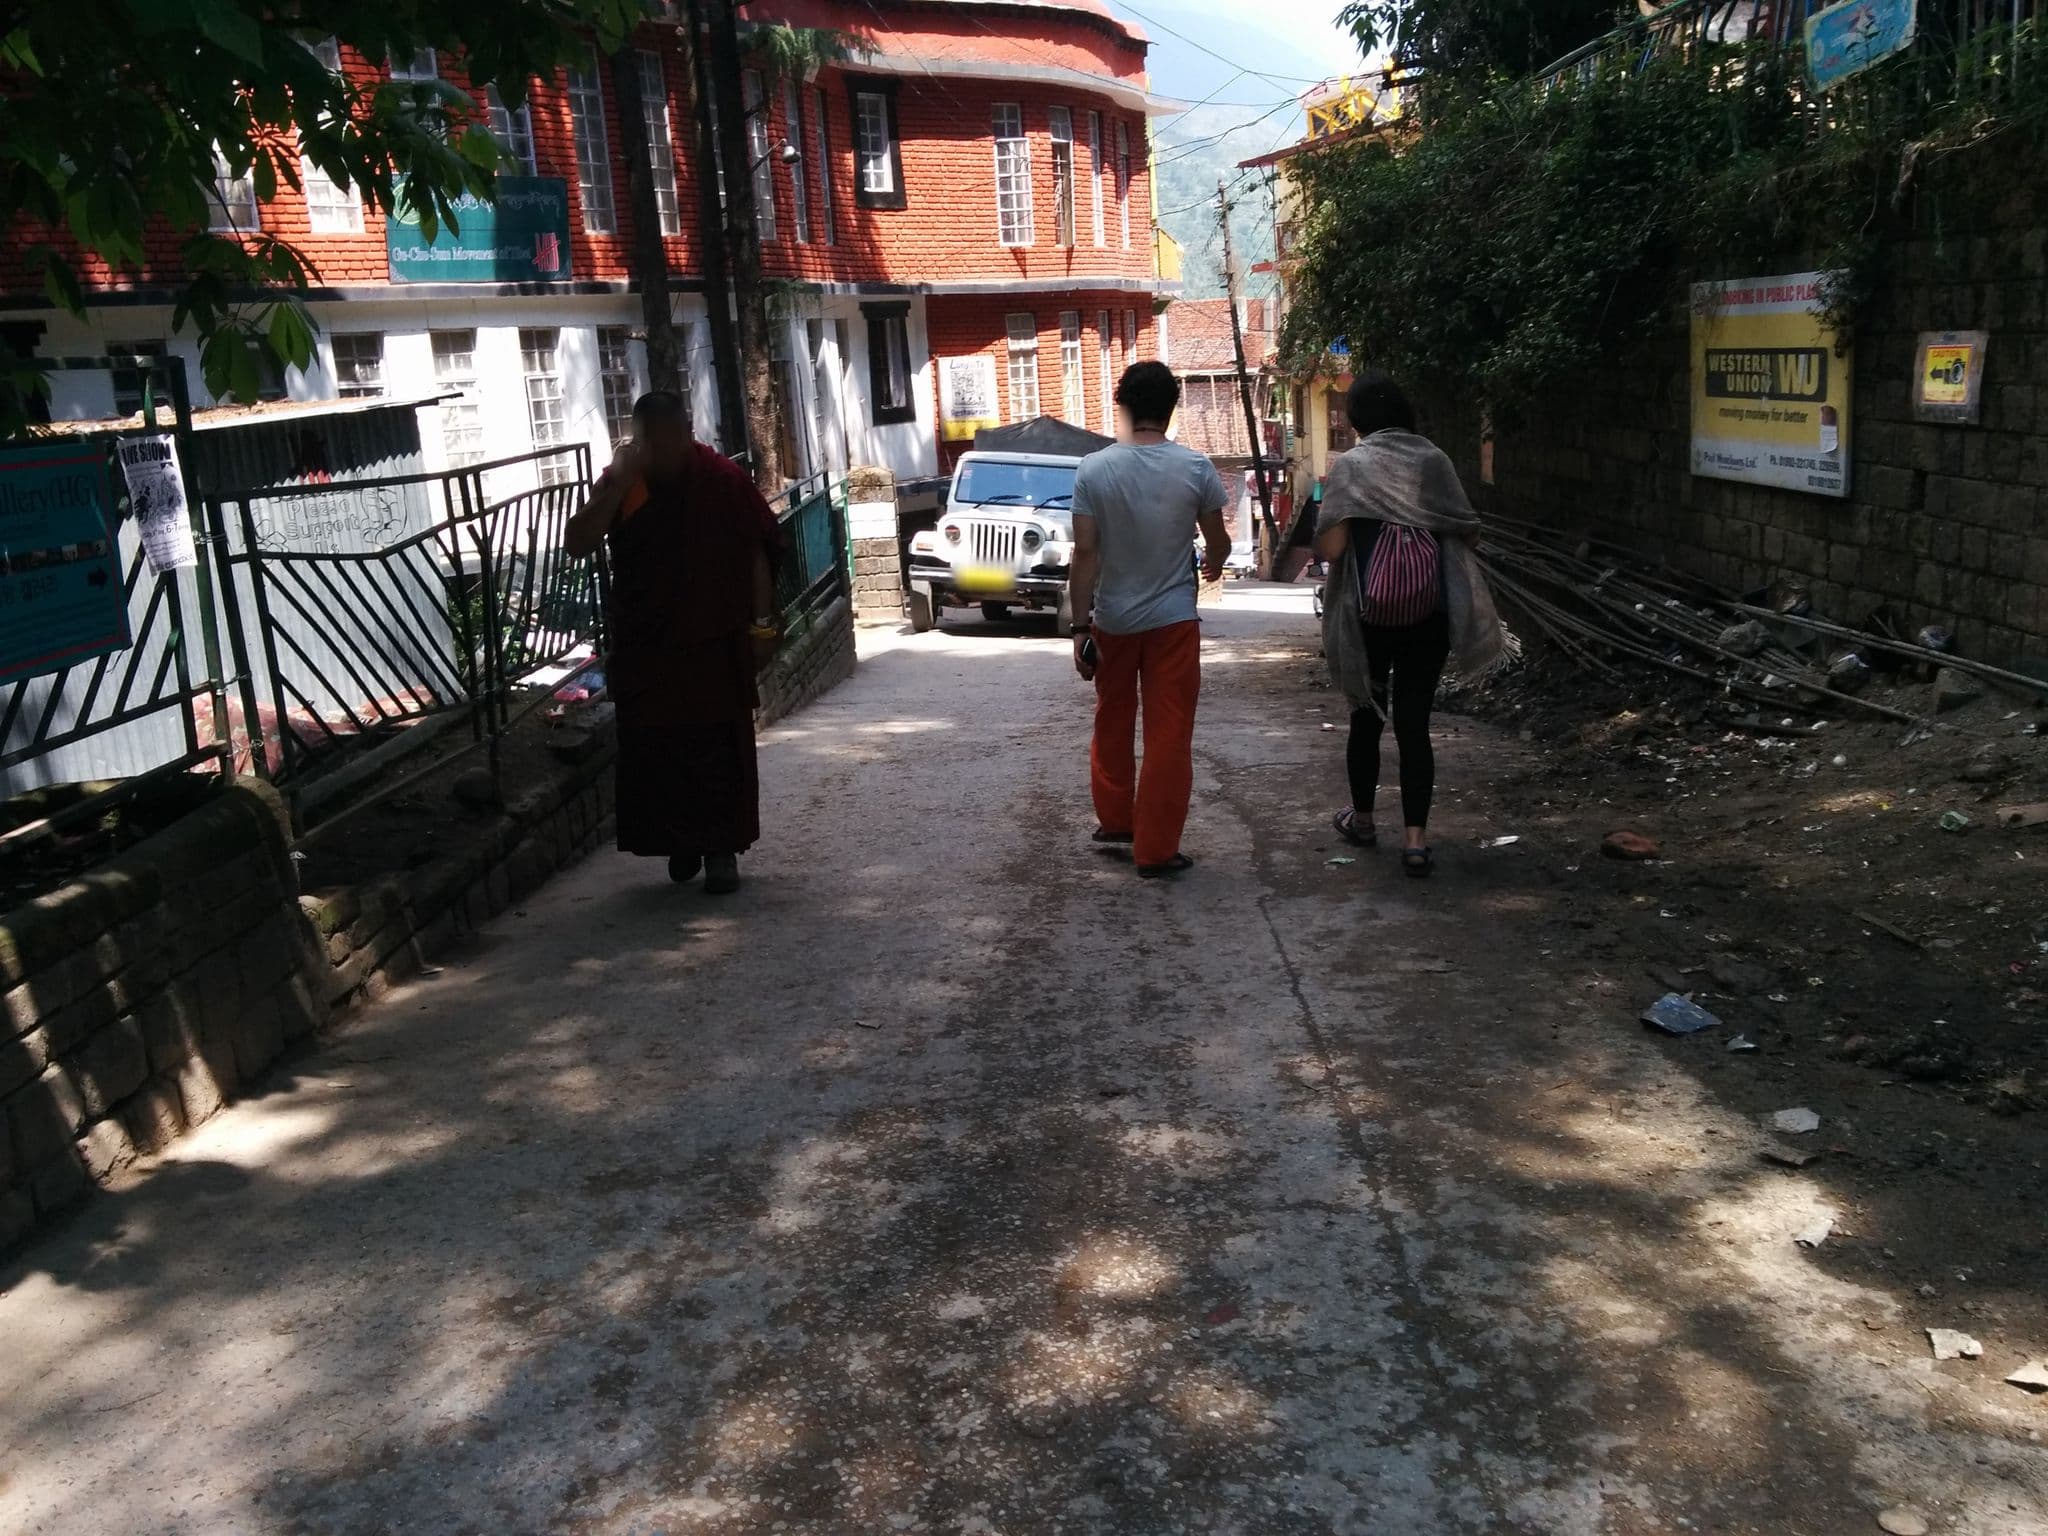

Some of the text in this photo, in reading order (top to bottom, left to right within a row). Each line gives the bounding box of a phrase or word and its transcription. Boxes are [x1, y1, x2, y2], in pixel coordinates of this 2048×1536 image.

[1766, 285, 1794, 303] PUBLIC
[1708, 353, 1820, 396] WESTERN WU
[1726, 373, 1773, 394] UNION
[1745, 408, 1769, 424] money
[1783, 410, 1808, 424] better
